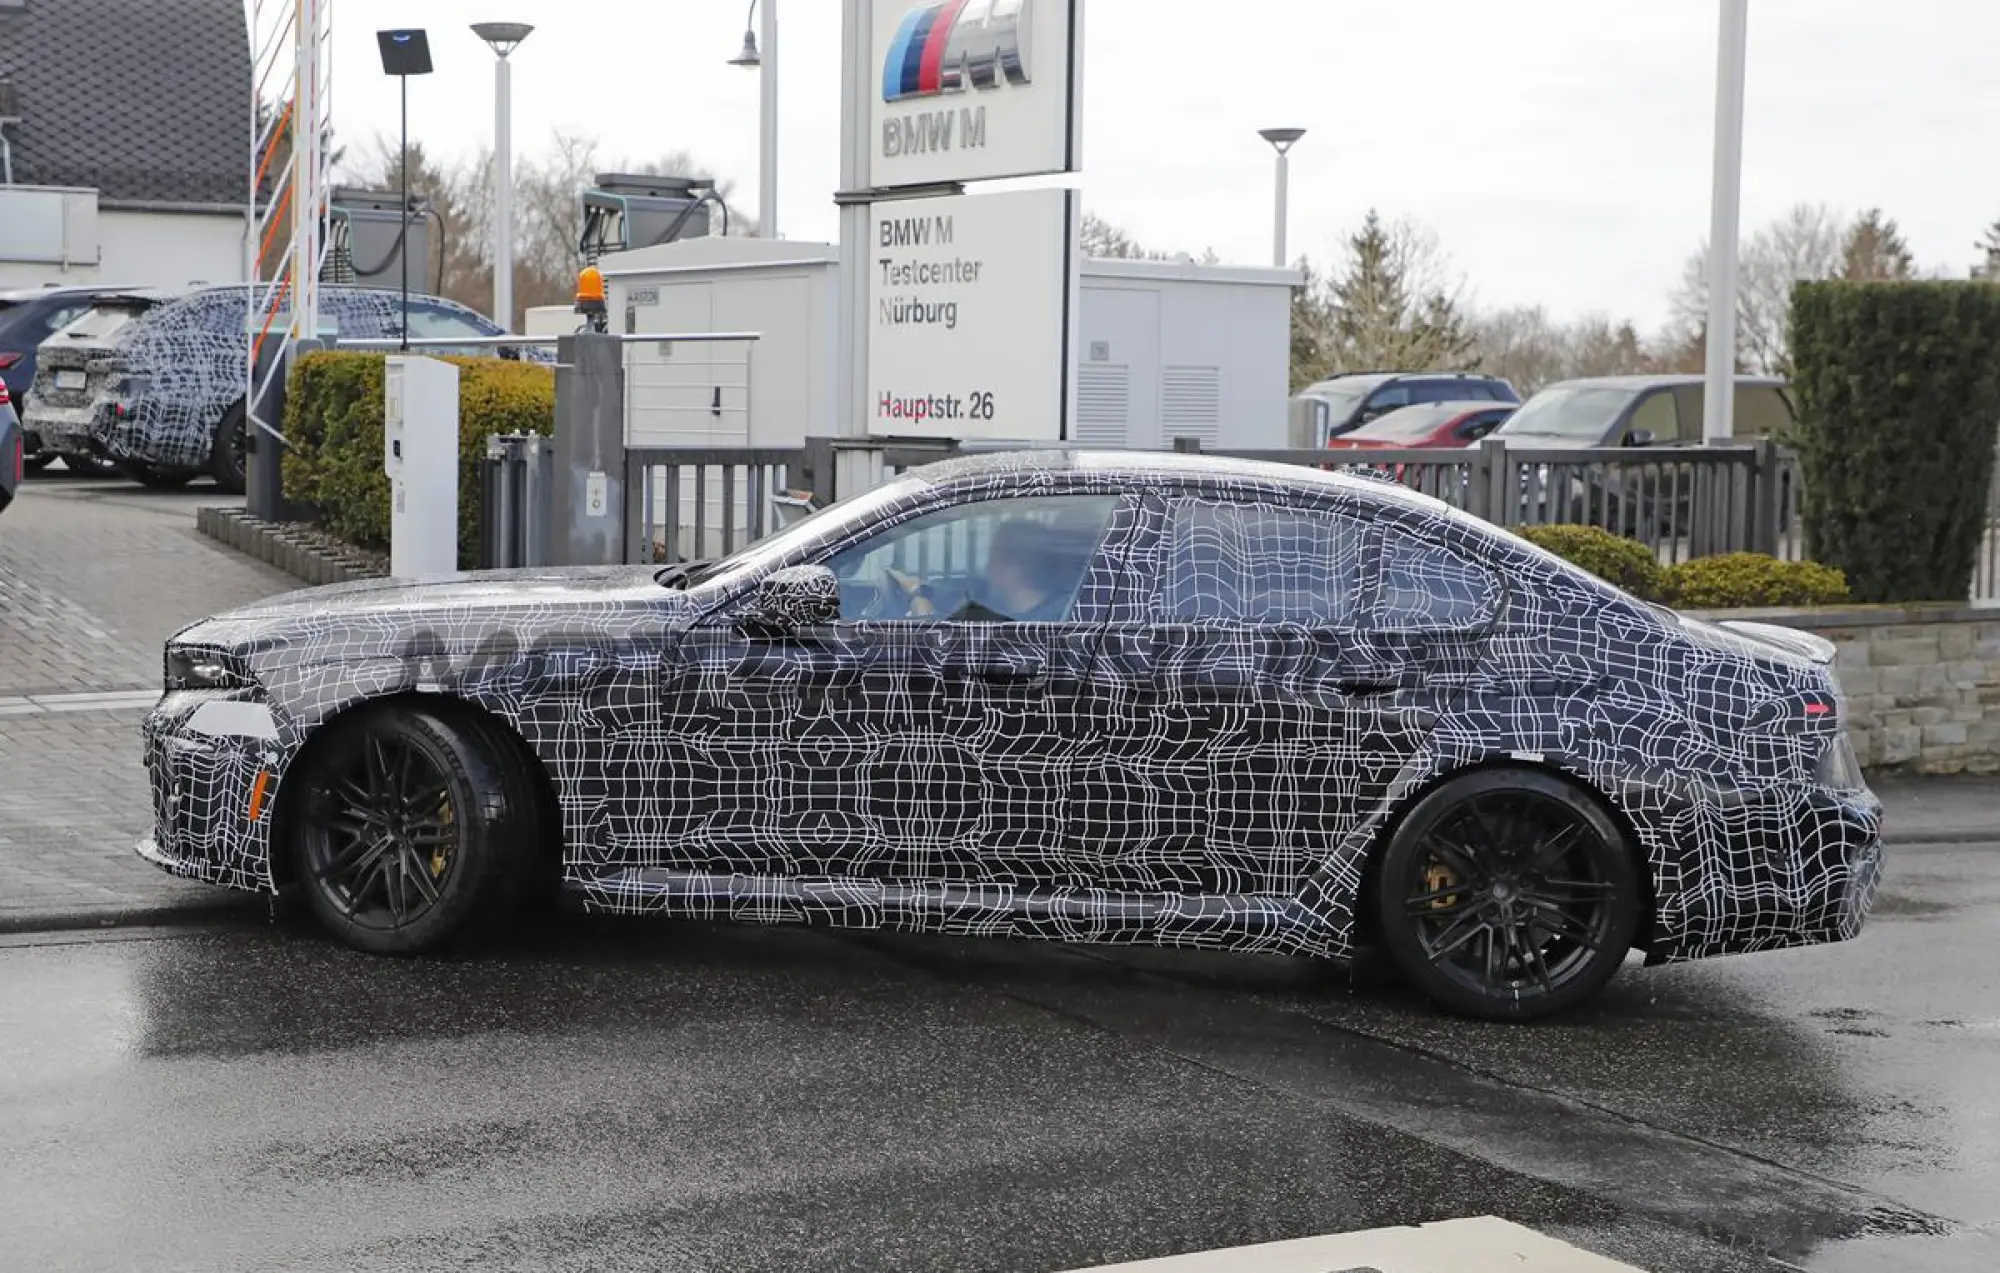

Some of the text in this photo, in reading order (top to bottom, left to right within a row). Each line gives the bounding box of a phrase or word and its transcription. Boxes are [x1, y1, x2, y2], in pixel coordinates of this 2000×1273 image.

[883, 106, 986, 157] BMW M
[880, 215, 953, 247] BMW M
[879, 257, 982, 286] Testcenter
[880, 296, 957, 329] Nürburg
[878, 390, 994, 424] Hauptstr. 26
